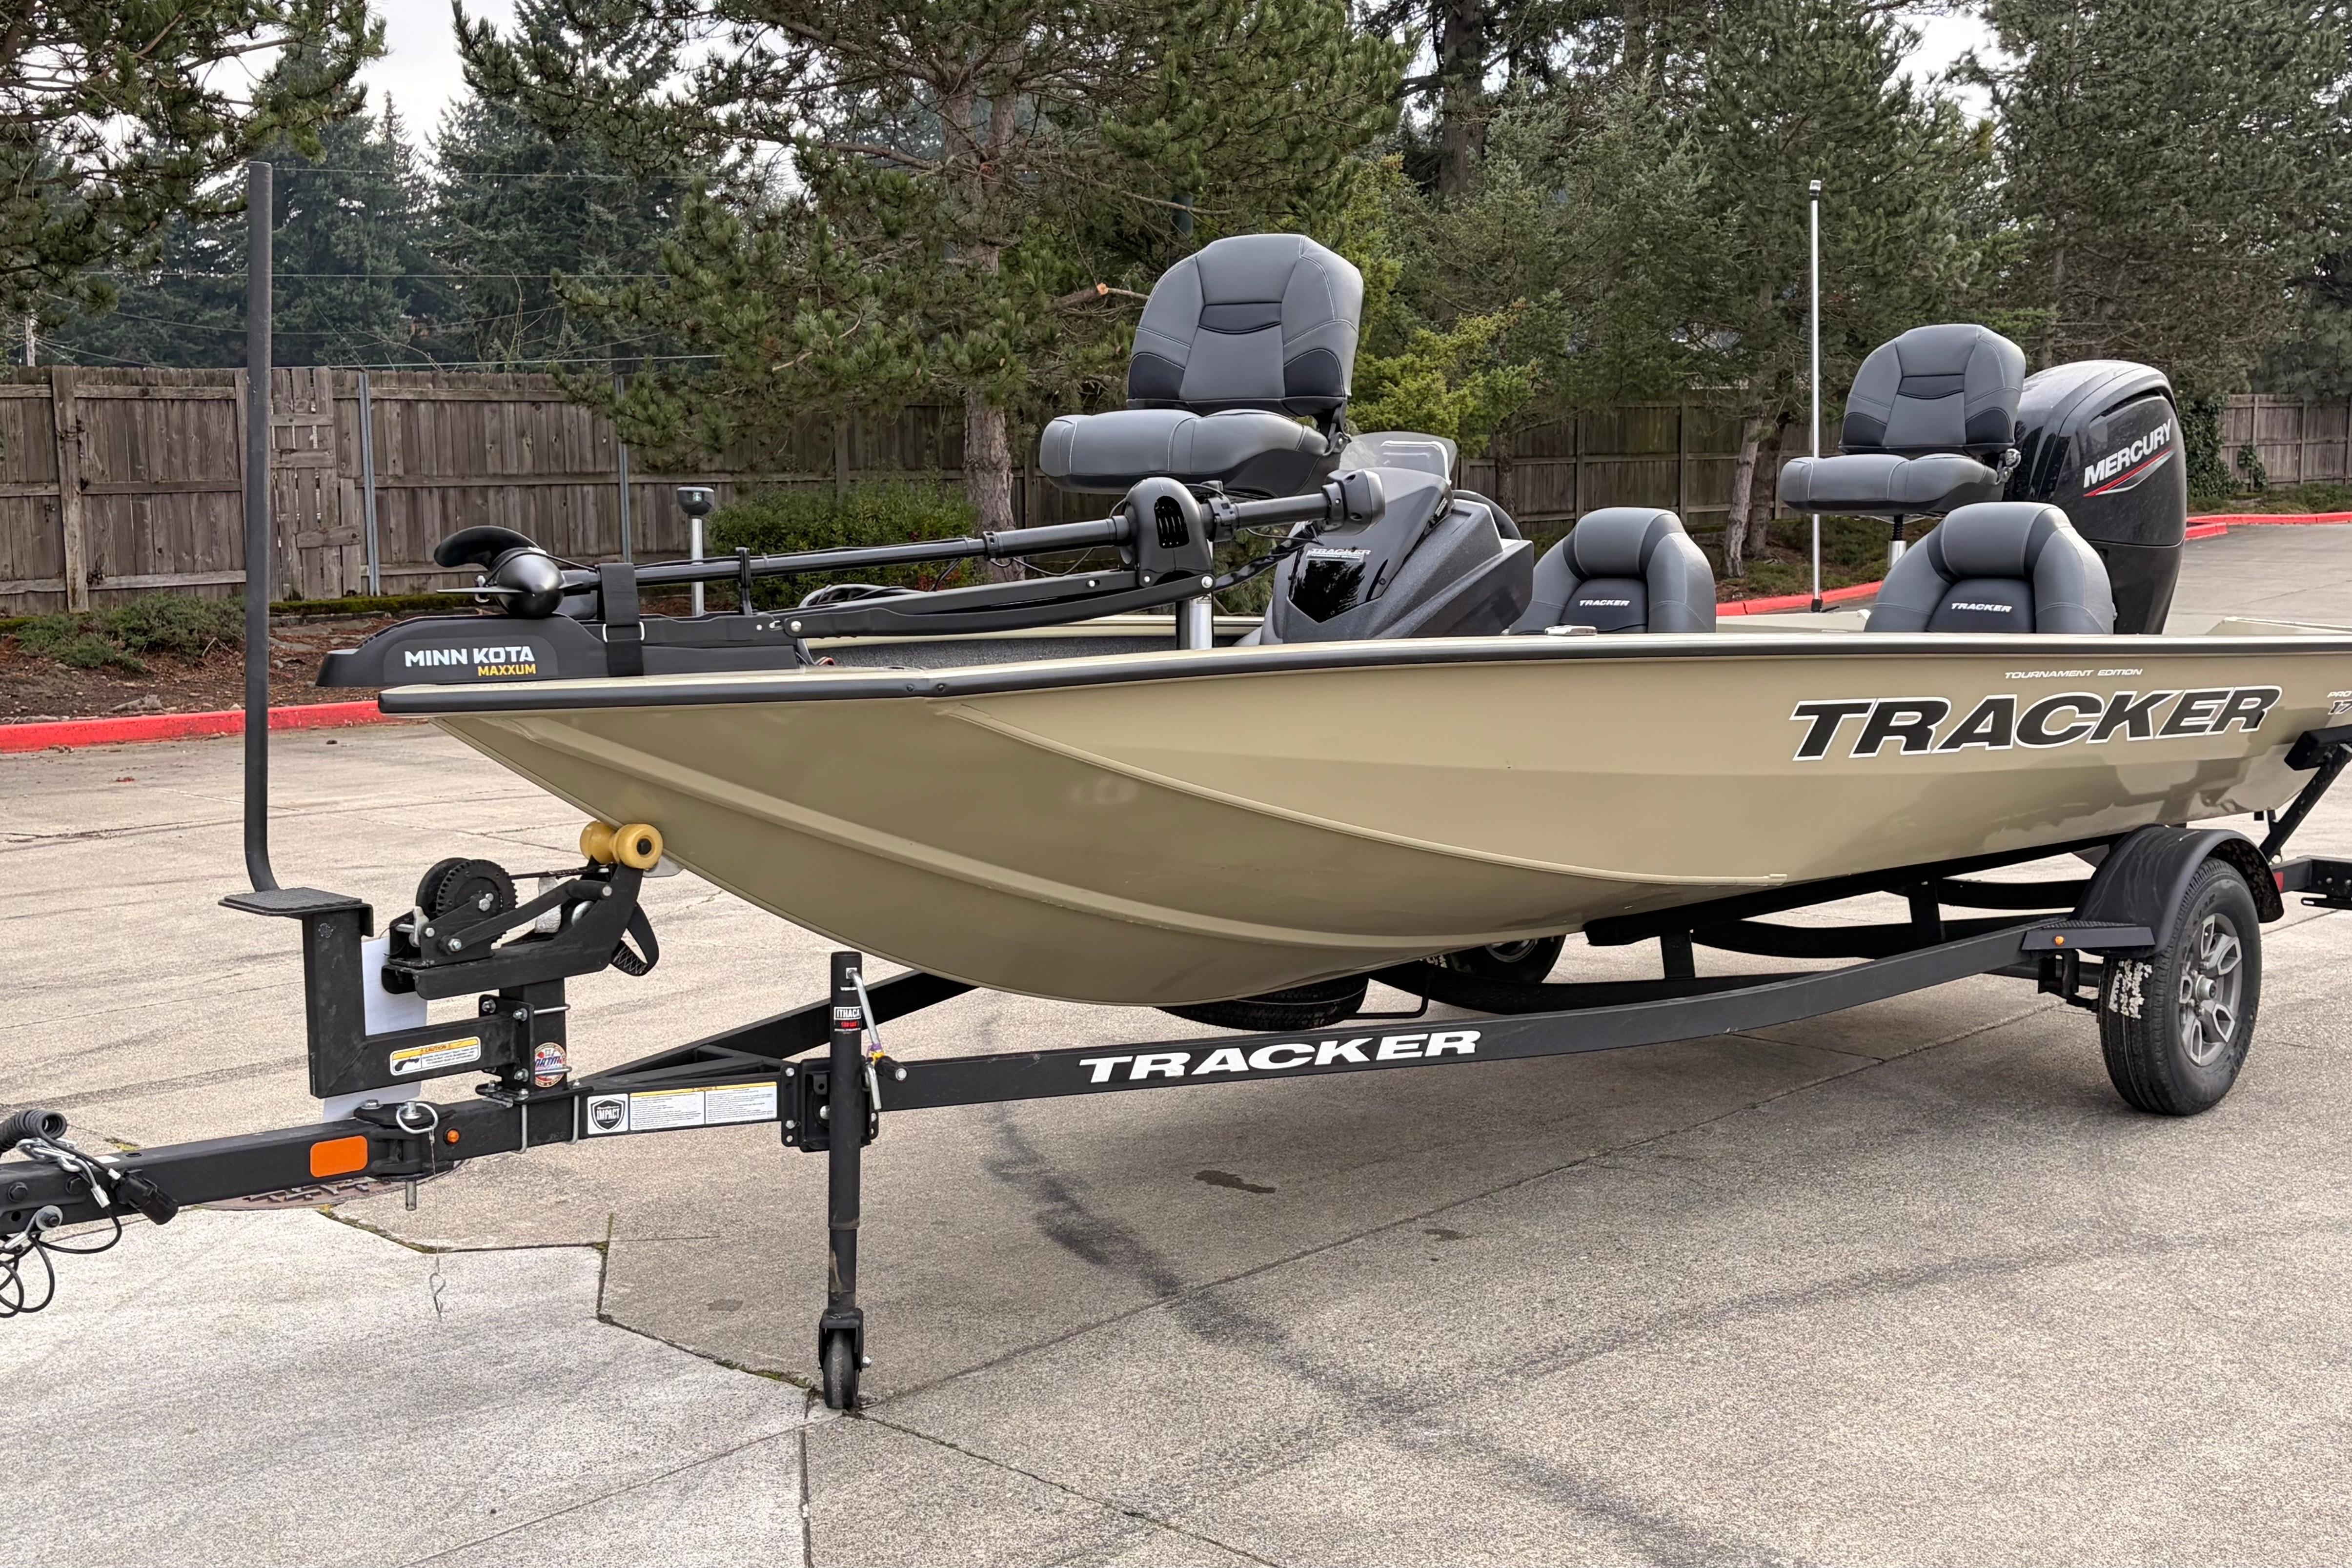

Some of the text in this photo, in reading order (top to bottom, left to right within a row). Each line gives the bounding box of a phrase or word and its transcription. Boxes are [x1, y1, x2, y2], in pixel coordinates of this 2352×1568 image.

[2084, 418, 2171, 489] MERCURY
[1951, 603, 2012, 612] TRACKER
[405, 646, 535, 667] MINN KOTA
[478, 664, 536, 676] MAXXUM
[2005, 670, 2094, 679] TOURNAMENT
[1789, 686, 2282, 761] TRACKER
[836, 1008, 860, 1018] ITHACA
[1079, 1030, 1481, 1083] TRACKER
[596, 1108, 620, 1120] IMPACT
